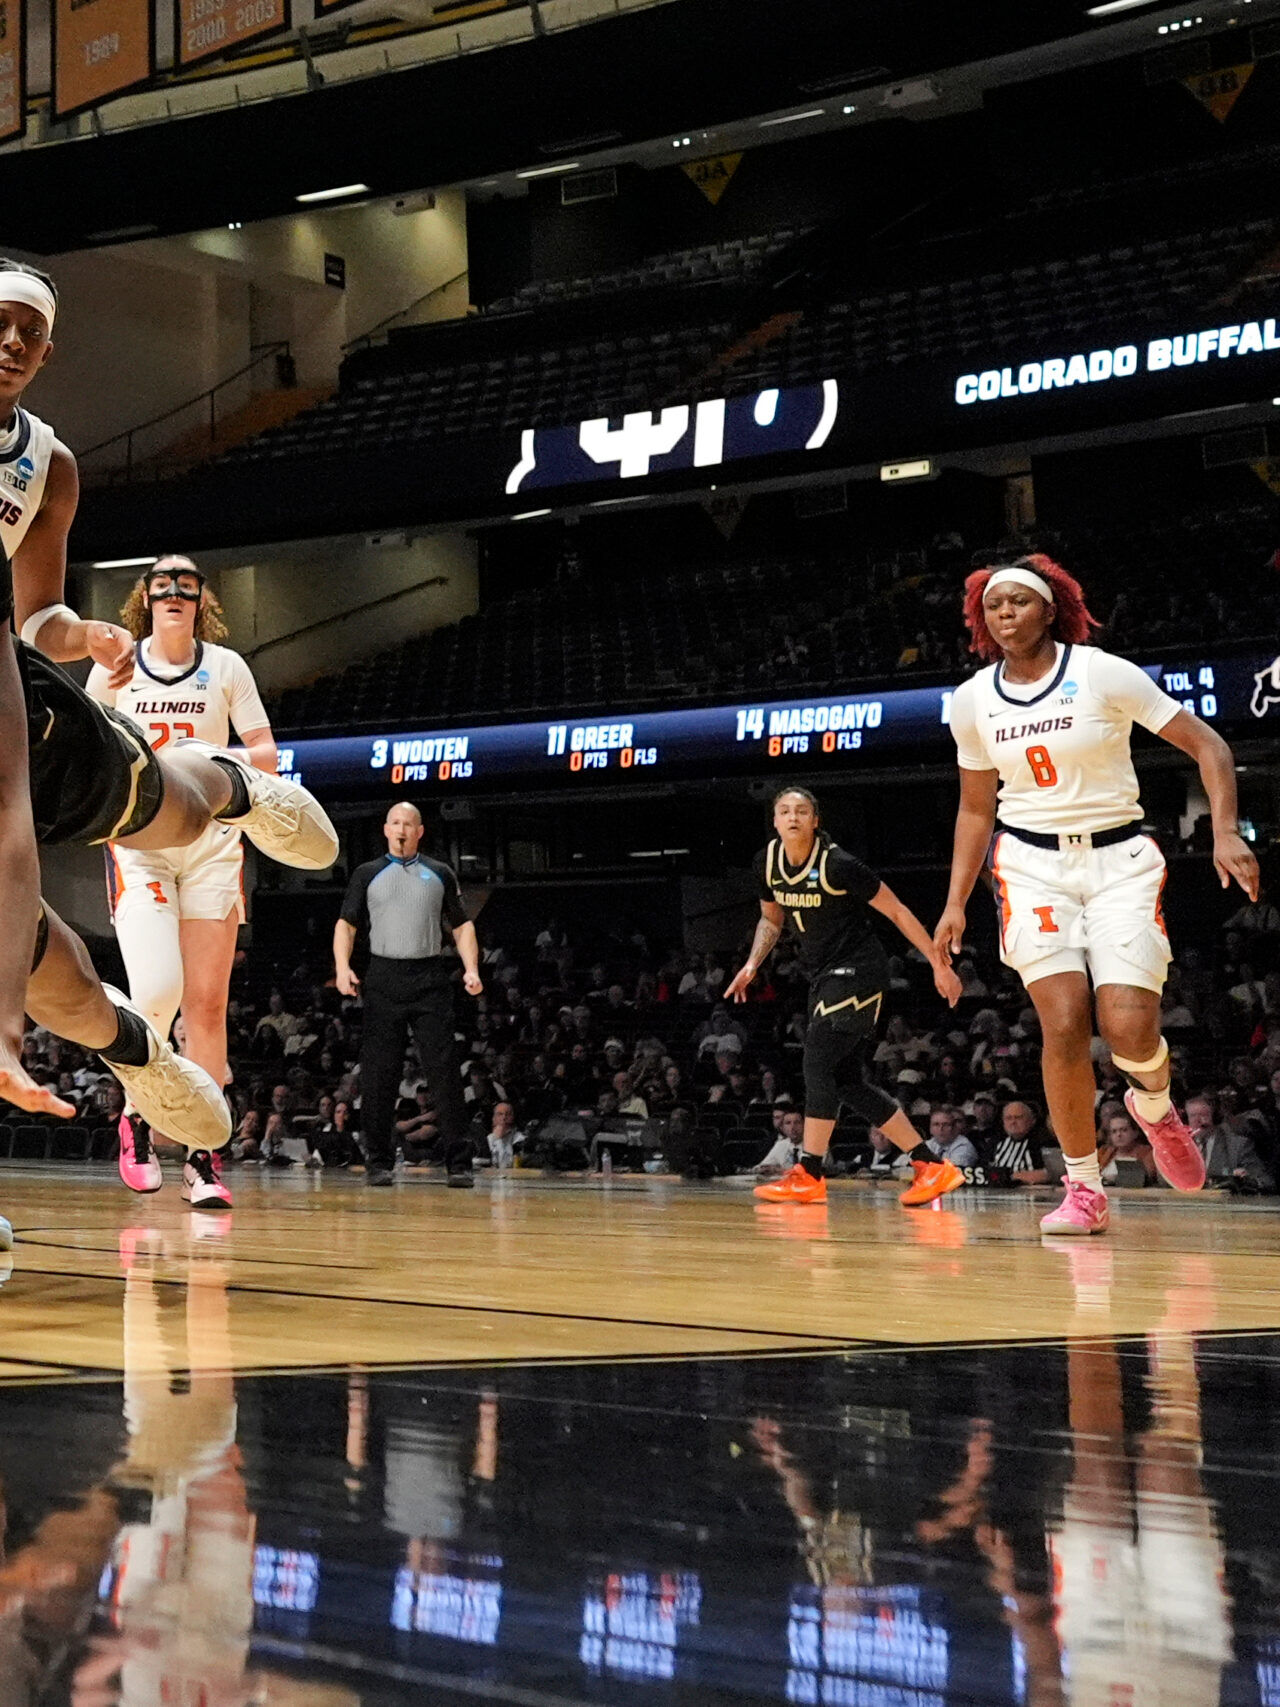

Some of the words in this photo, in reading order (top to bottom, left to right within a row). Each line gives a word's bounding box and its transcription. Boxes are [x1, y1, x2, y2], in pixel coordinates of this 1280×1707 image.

[955, 345, 1138, 405] COLORADO
[1163, 672, 1194, 692] TOL
[1199, 666, 1214, 689] 4
[135, 701, 207, 714] ILLINOIS
[1201, 694, 1218, 717] 0
[736, 708, 764, 741] 14
[769, 702, 883, 736] MASOGAYO
[995, 716, 1074, 744] ILLINOIS
[370, 739, 389, 768] 3
[392, 736, 469, 765] WOOTEN
[548, 725, 567, 755] 11
[570, 723, 634, 752] GREER
[768, 736, 782, 757] 6
[783, 735, 809, 754] PTS
[822, 731, 836, 753] 0
[837, 731, 862, 750] FLS
[570, 751, 582, 771] 0
[583, 751, 608, 769] PTS
[620, 748, 633, 768] 0
[634, 747, 657, 765] FLS
[1025, 745, 1058, 788] 8
[391, 765, 404, 784] 0
[404, 765, 428, 782] PTS
[438, 761, 451, 781] 0
[451, 761, 473, 778] FLS
[792, 910, 806, 933] 1
